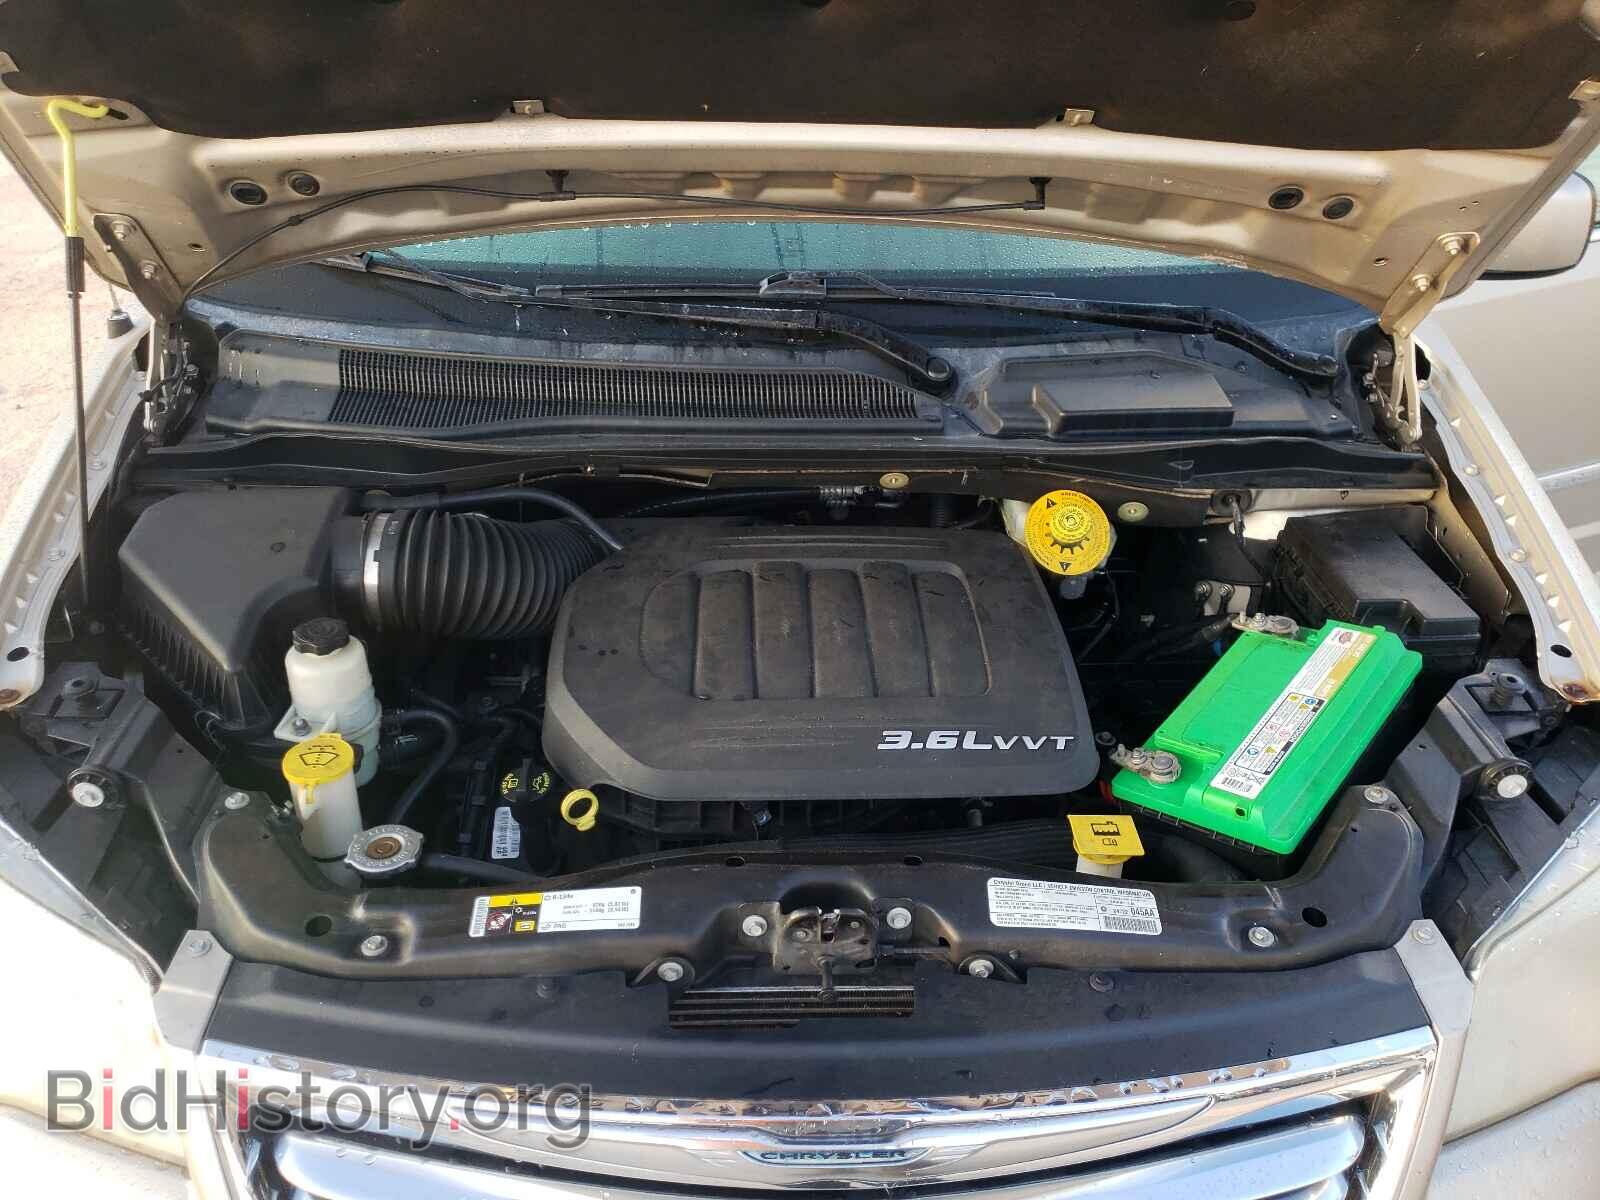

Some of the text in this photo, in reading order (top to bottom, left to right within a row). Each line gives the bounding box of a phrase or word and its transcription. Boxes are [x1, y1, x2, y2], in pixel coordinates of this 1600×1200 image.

[876, 730, 1075, 750] 3.6L VVT
[760, 1150, 906, 1161] CHRYSLER
